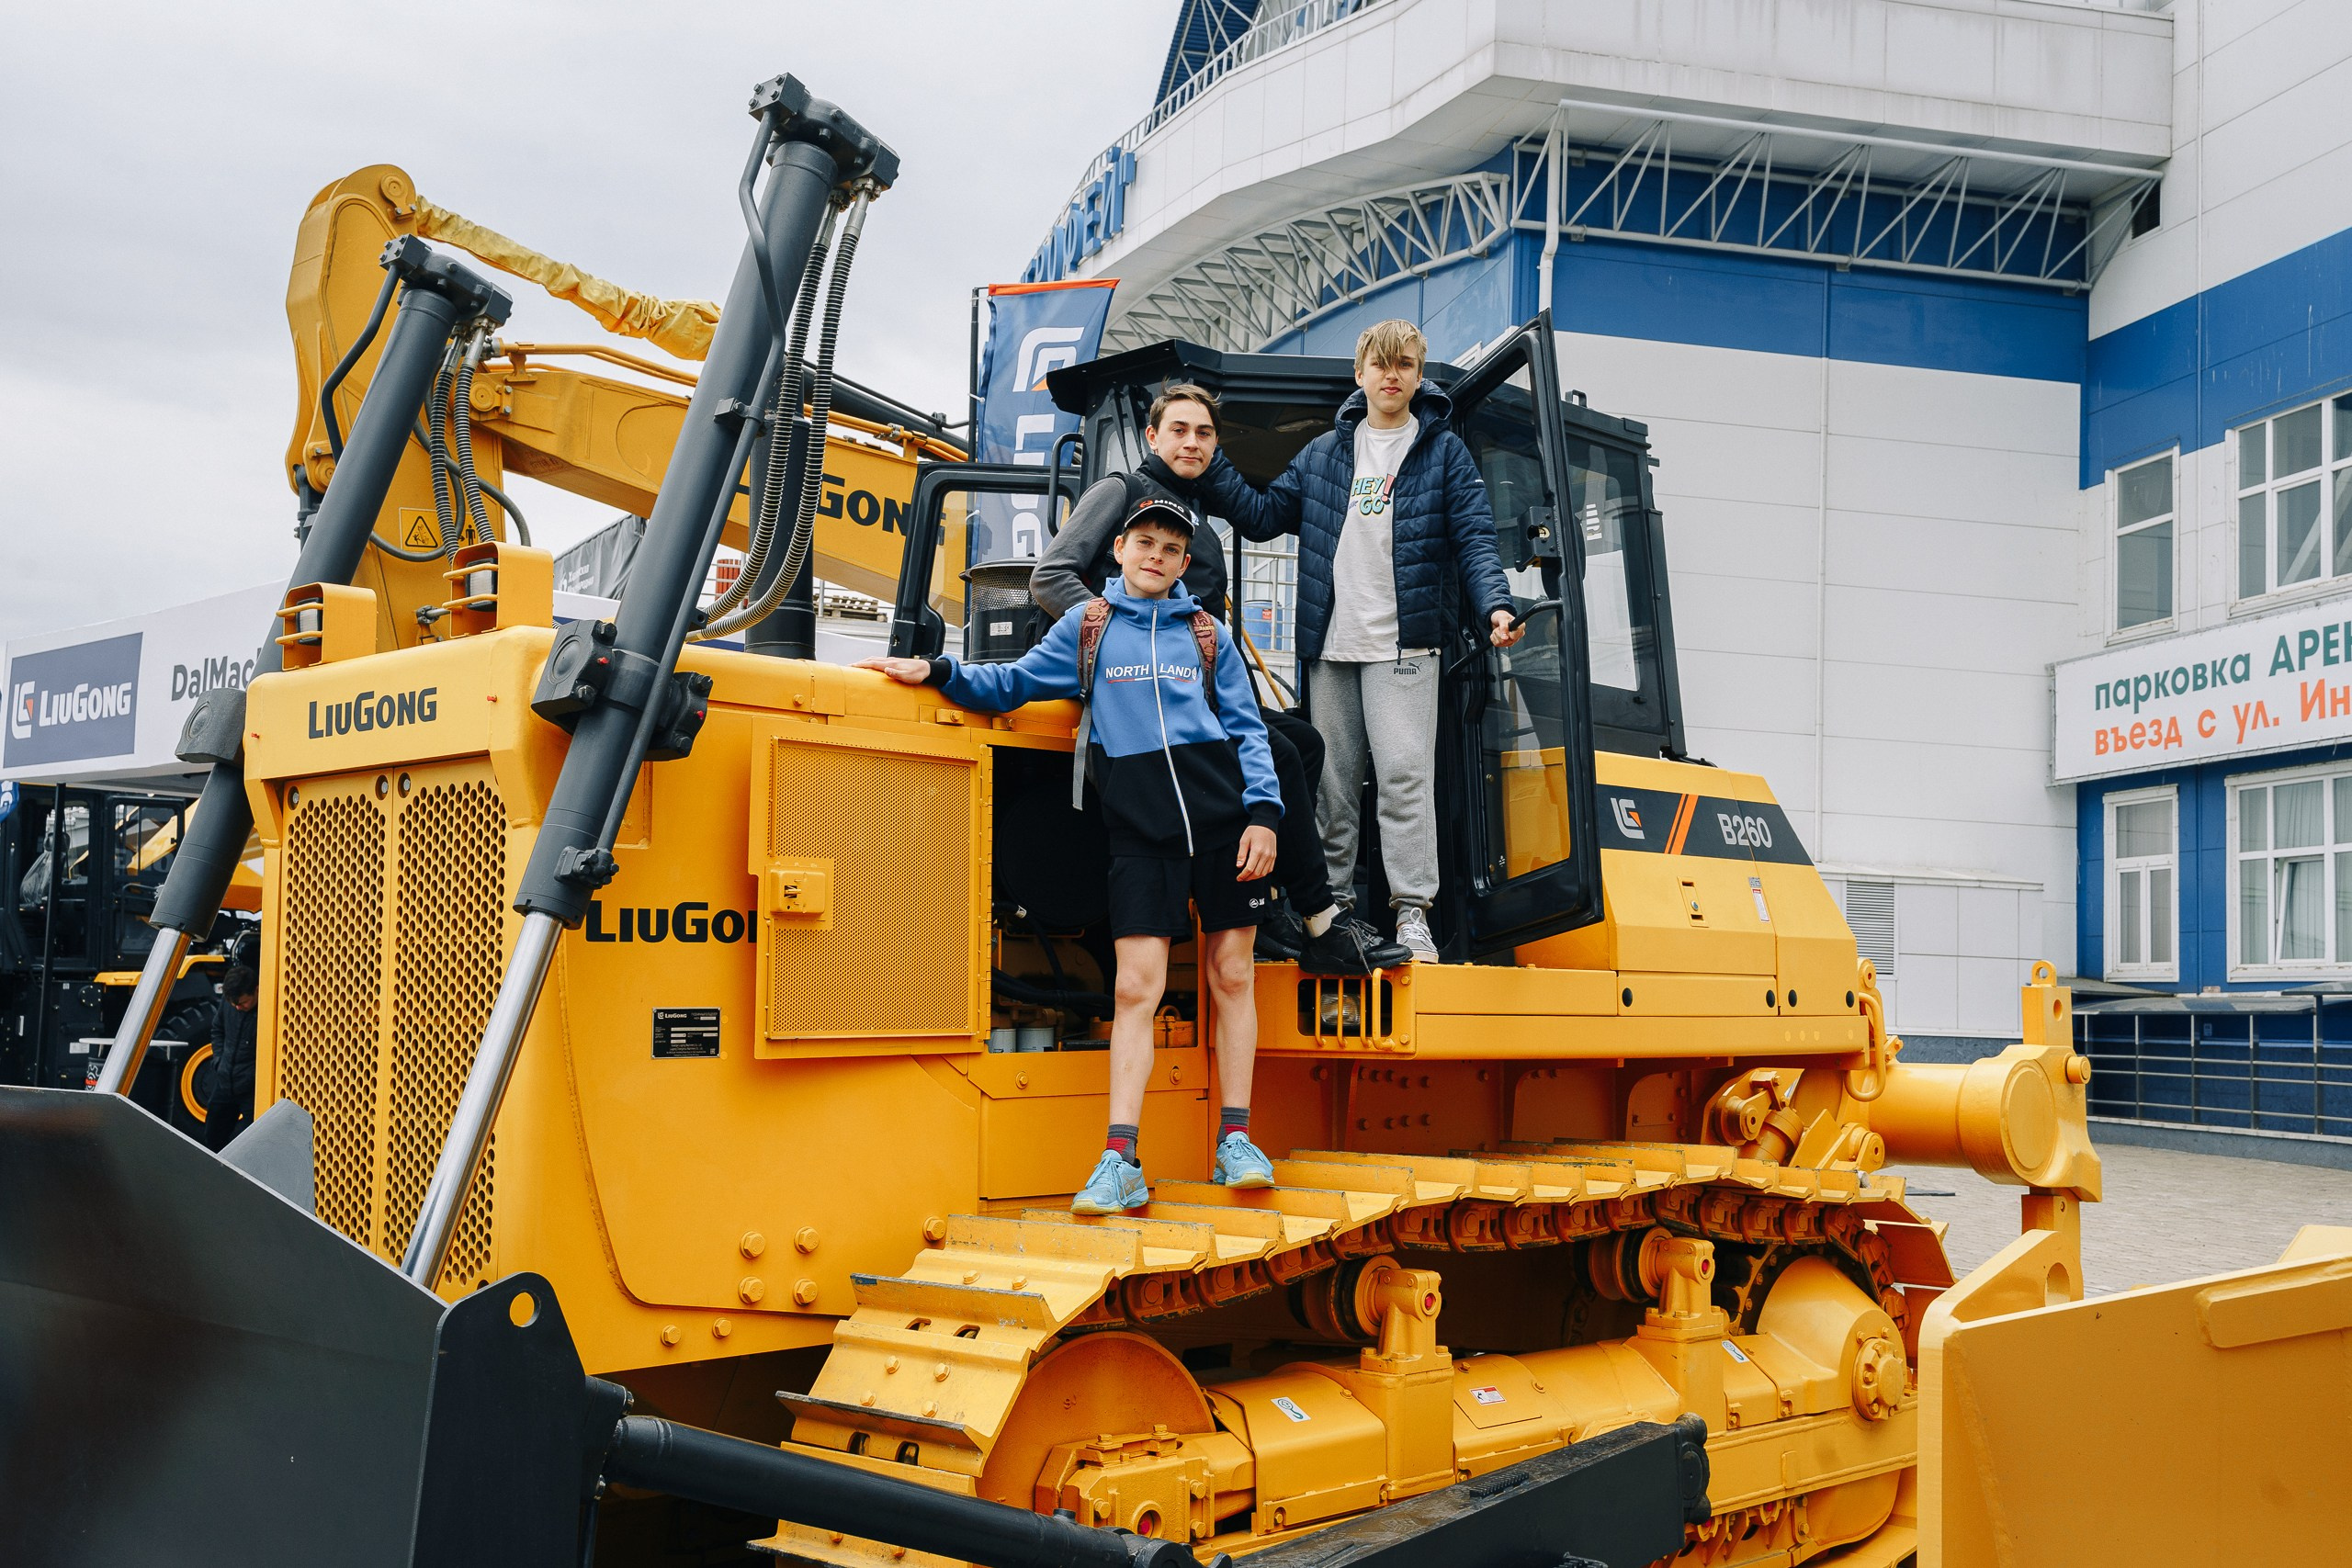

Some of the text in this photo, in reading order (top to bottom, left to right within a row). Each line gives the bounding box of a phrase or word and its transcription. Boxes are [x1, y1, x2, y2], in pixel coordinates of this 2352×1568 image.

[1154, 499, 1185, 513] HINO
[1360, 496, 1385, 515] GO
[171, 647, 262, 702] DalMac
[1105, 663, 1149, 679] NORTH
[1393, 667, 1418, 675] PUMA
[2095, 652, 2251, 715] парковка
[39, 682, 132, 728] LIUGONG
[309, 687, 437, 739] LIUGONG
[2095, 716, 2183, 756] въезд
[2198, 708, 2216, 739] с
[2232, 700, 2279, 745] ул.
[1717, 813, 1772, 848] B260
